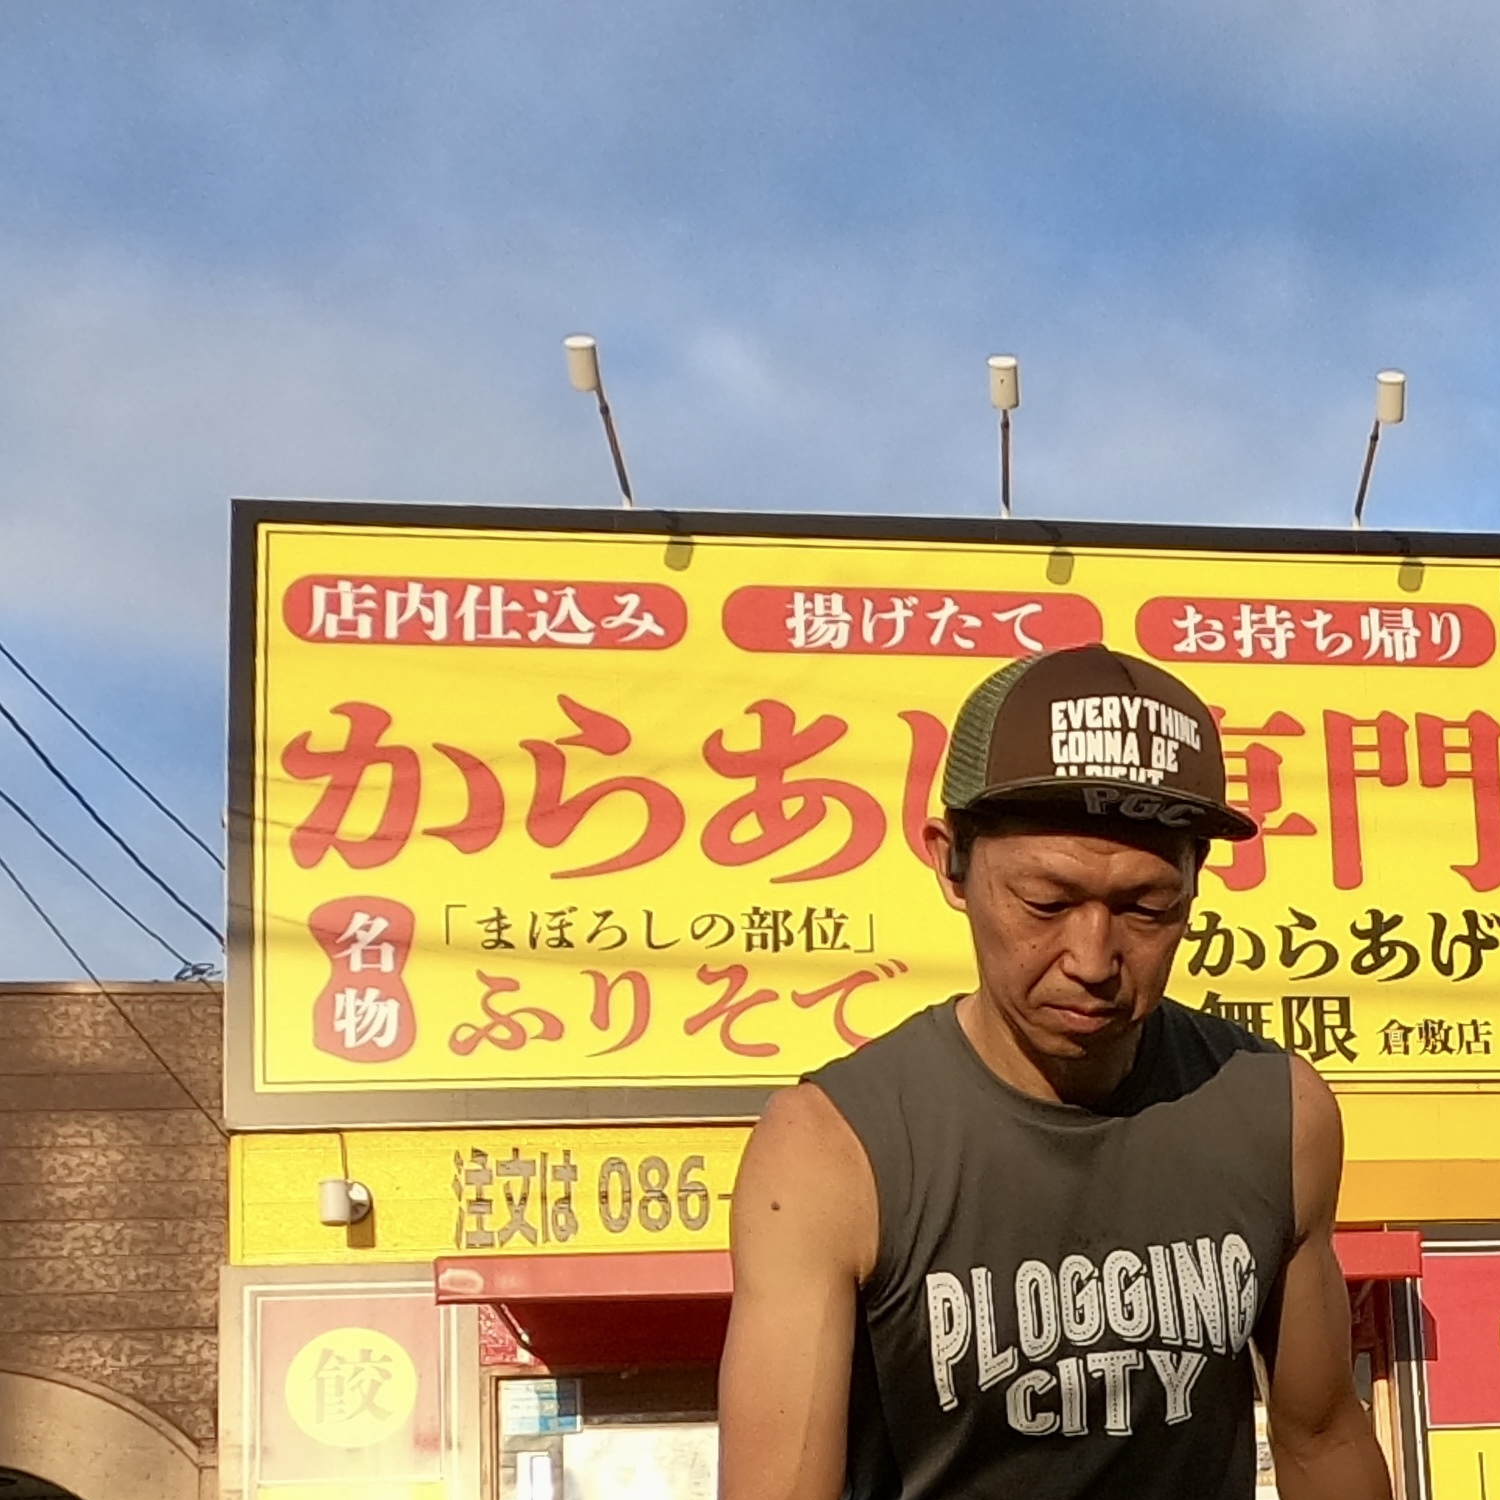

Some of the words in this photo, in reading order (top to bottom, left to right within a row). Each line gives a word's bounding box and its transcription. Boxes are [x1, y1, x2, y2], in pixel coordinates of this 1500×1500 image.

[307, 583, 665, 645] 店内仕込み
[785, 592, 1048, 652] 揚げたて
[1172, 603, 1463, 662] お持ち帰り
[1051, 695, 1201, 752] EVERYTHING
[1052, 731, 1140, 767] GONNA
[1152, 734, 1180, 773] BE
[443, 903, 877, 954] 「まぼろしの部位」
[333, 911, 399, 1050] 名物
[448, 960, 909, 1059] ふりそで
[1378, 1019, 1493, 1056] 倉敷店
[451, 1147, 579, 1249] 注文は
[924, 1232, 1260, 1413] PLOGGING
[309, 1346, 394, 1426] 餃
[1005, 1347, 1208, 1438] CITY
